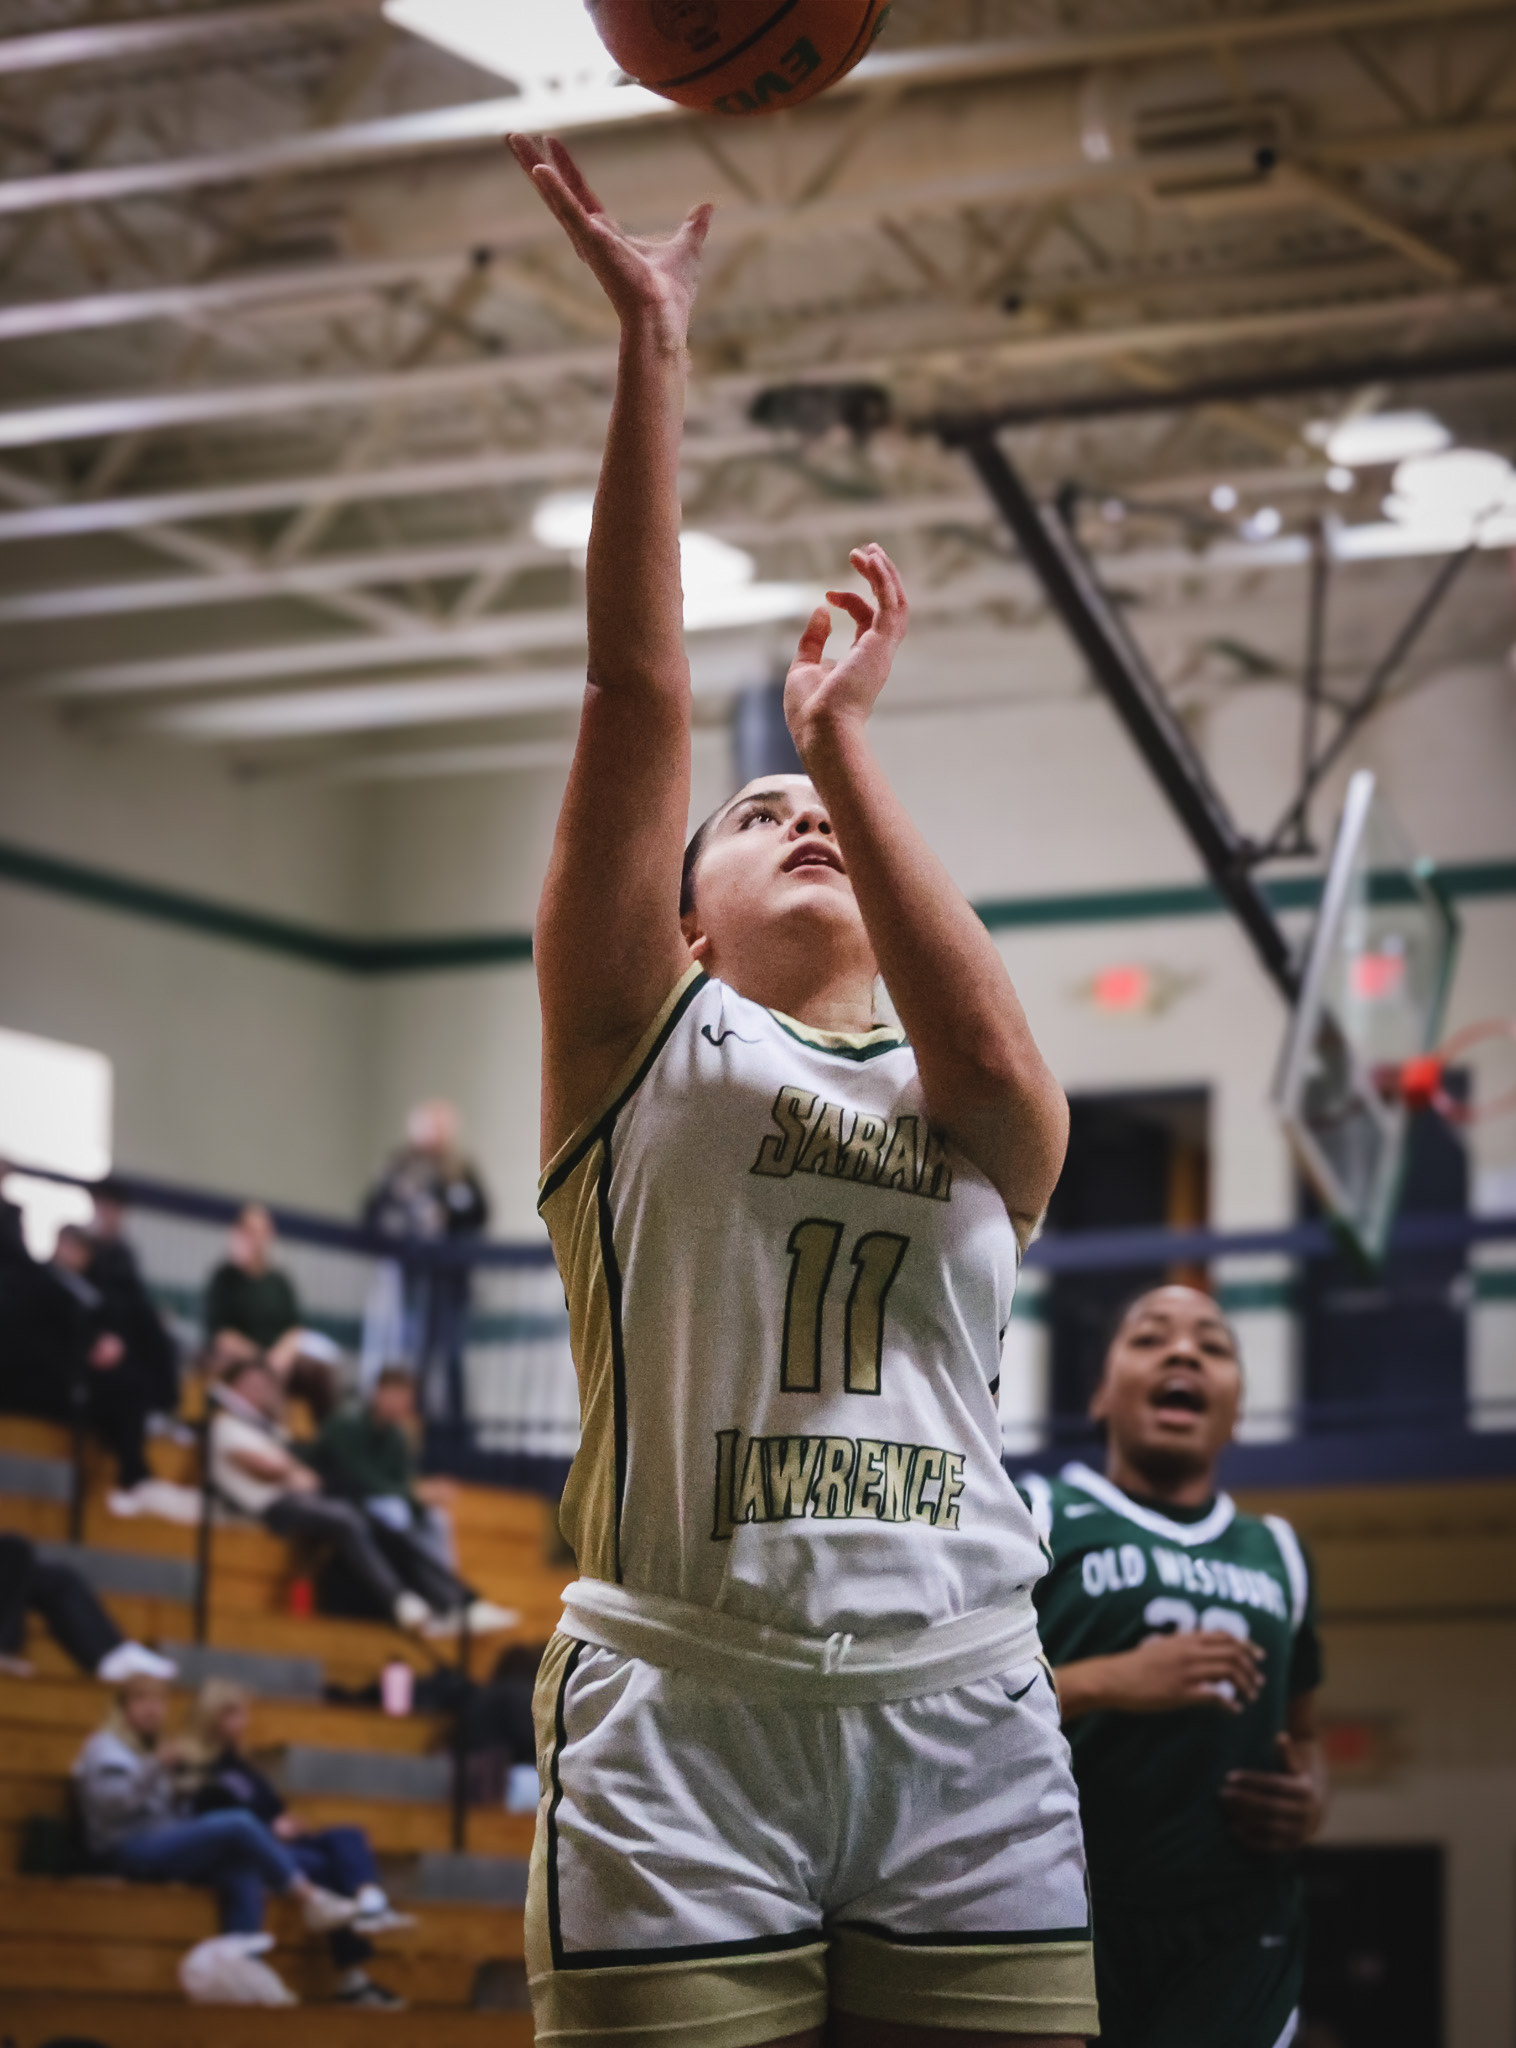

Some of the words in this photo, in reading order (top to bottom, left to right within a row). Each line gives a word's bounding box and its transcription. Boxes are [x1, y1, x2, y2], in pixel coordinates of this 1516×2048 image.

[780, 1218, 909, 1396] 11
[711, 1429, 966, 1540] LAWRENCE
[1082, 1544, 1147, 1597] OLD
